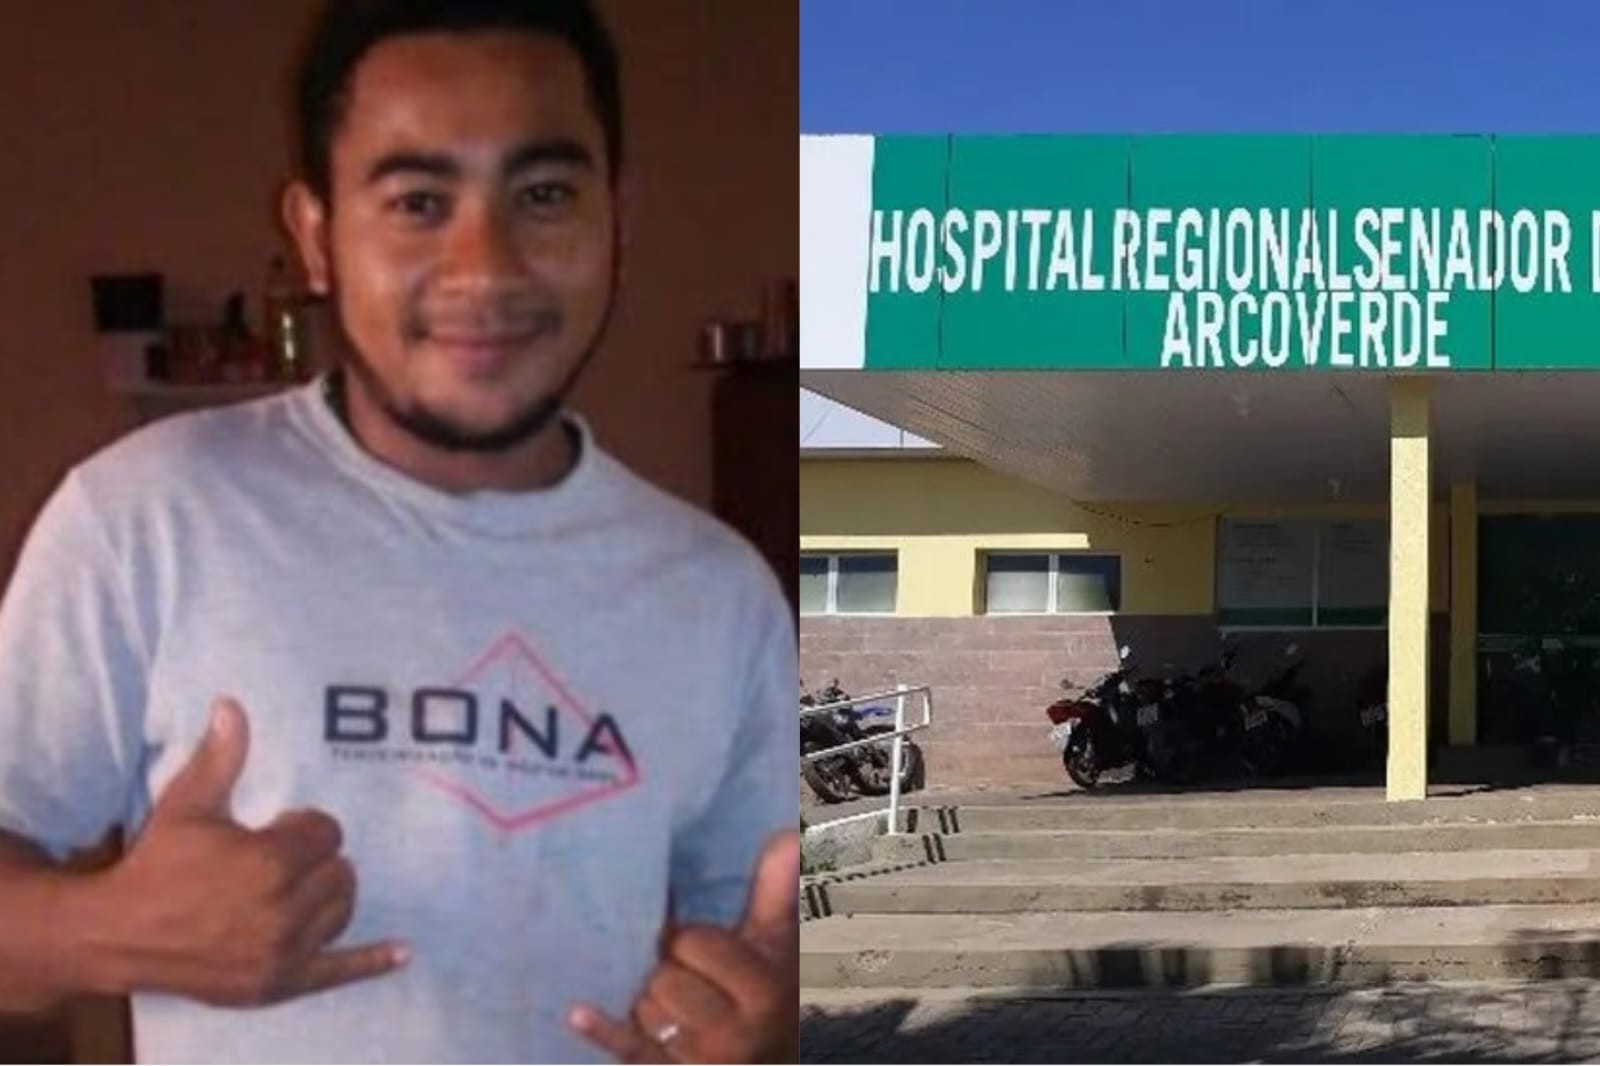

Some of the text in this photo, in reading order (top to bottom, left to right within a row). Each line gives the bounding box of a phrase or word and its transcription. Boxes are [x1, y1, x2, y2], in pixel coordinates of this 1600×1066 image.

[869, 207, 1105, 293] HOSPITAL
[1111, 207, 1352, 291] REGIONAL
[1352, 207, 1572, 293] SENADOR
[1160, 291, 1451, 368] ARCOVERDE
[324, 685, 637, 771] BONA
